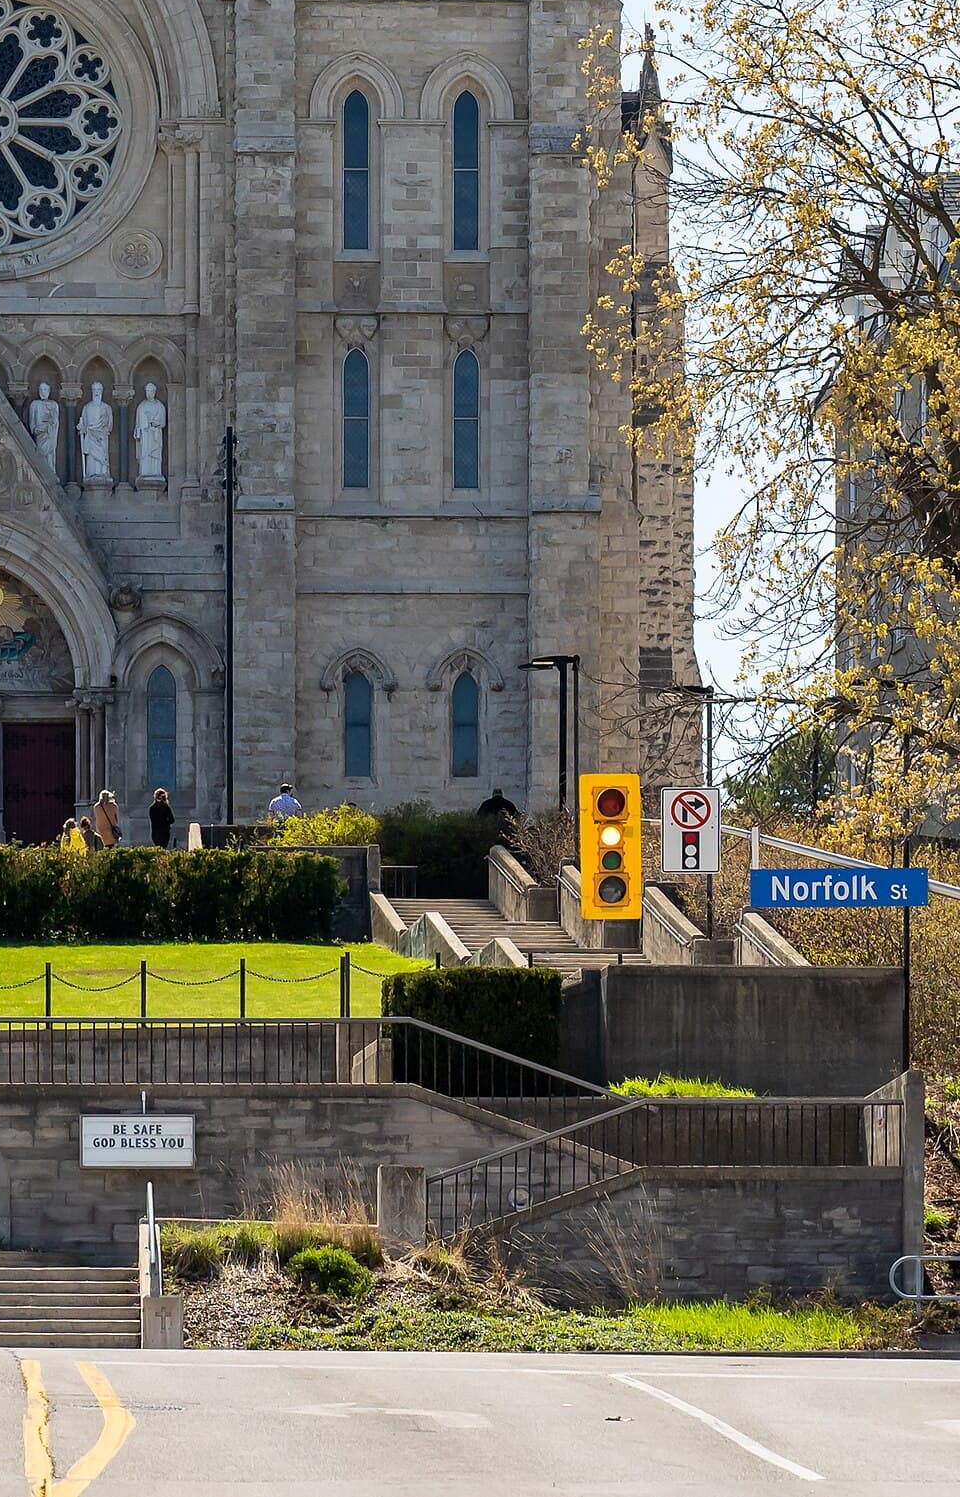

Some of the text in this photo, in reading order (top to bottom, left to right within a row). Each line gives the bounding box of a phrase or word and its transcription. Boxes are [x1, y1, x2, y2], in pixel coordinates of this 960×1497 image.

[771, 875, 908, 901] Norfolk St
[113, 1124, 162, 1135] BE SAFE
[93, 1138, 185, 1148] GOD BLESS YOU
